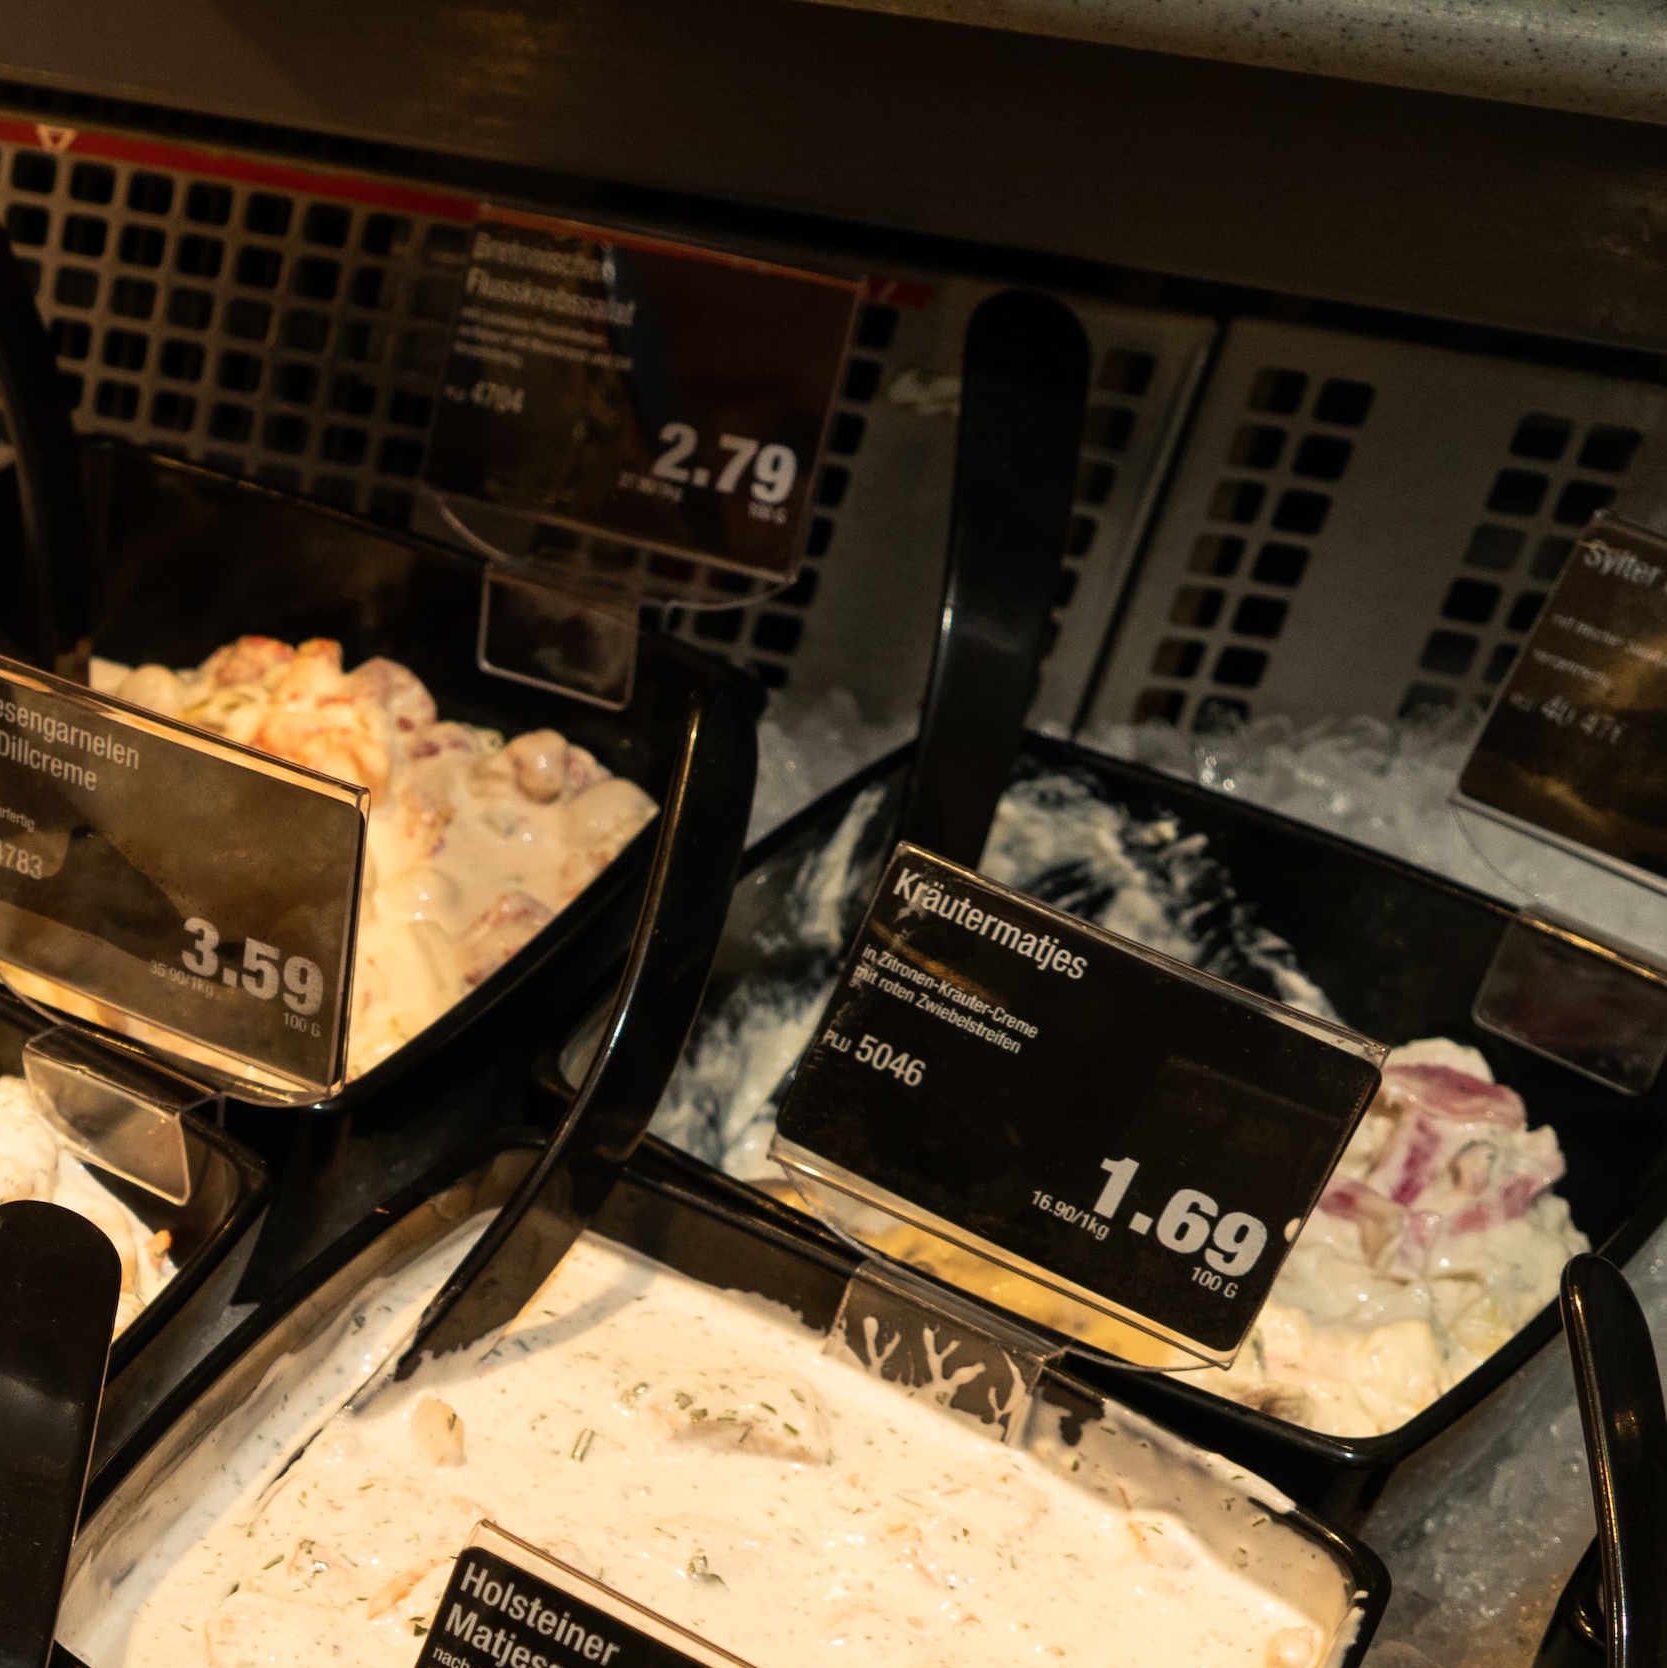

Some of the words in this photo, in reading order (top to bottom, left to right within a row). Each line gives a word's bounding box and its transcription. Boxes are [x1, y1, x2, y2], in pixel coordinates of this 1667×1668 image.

[651, 422, 798, 505] 2.79
[1583, 538, 1663, 587] Sylter
[181, 916, 324, 1016] 3.59
[892, 867, 1089, 980] Kräutermatjes
[282, 1011, 308, 1033] 100
[310, 1022, 321, 1038] G
[853, 964, 877, 986] mit
[877, 976, 916, 1003] roten
[915, 993, 1022, 1055] Zwiebelstreifen
[862, 943, 876, 962] in
[876, 950, 1039, 1040] Zitronen-Kräuter-Creme
[822, 1028, 852, 1053] PLU
[854, 1034, 927, 1088] 5046
[1031, 1189, 1110, 1241] 16.90/1kg
[1092, 1156, 1269, 1278] 1.69
[1190, 1265, 1221, 1293] 100
[1221, 1281, 1238, 1300] G
[459, 1561, 621, 1667] Holsteiner
